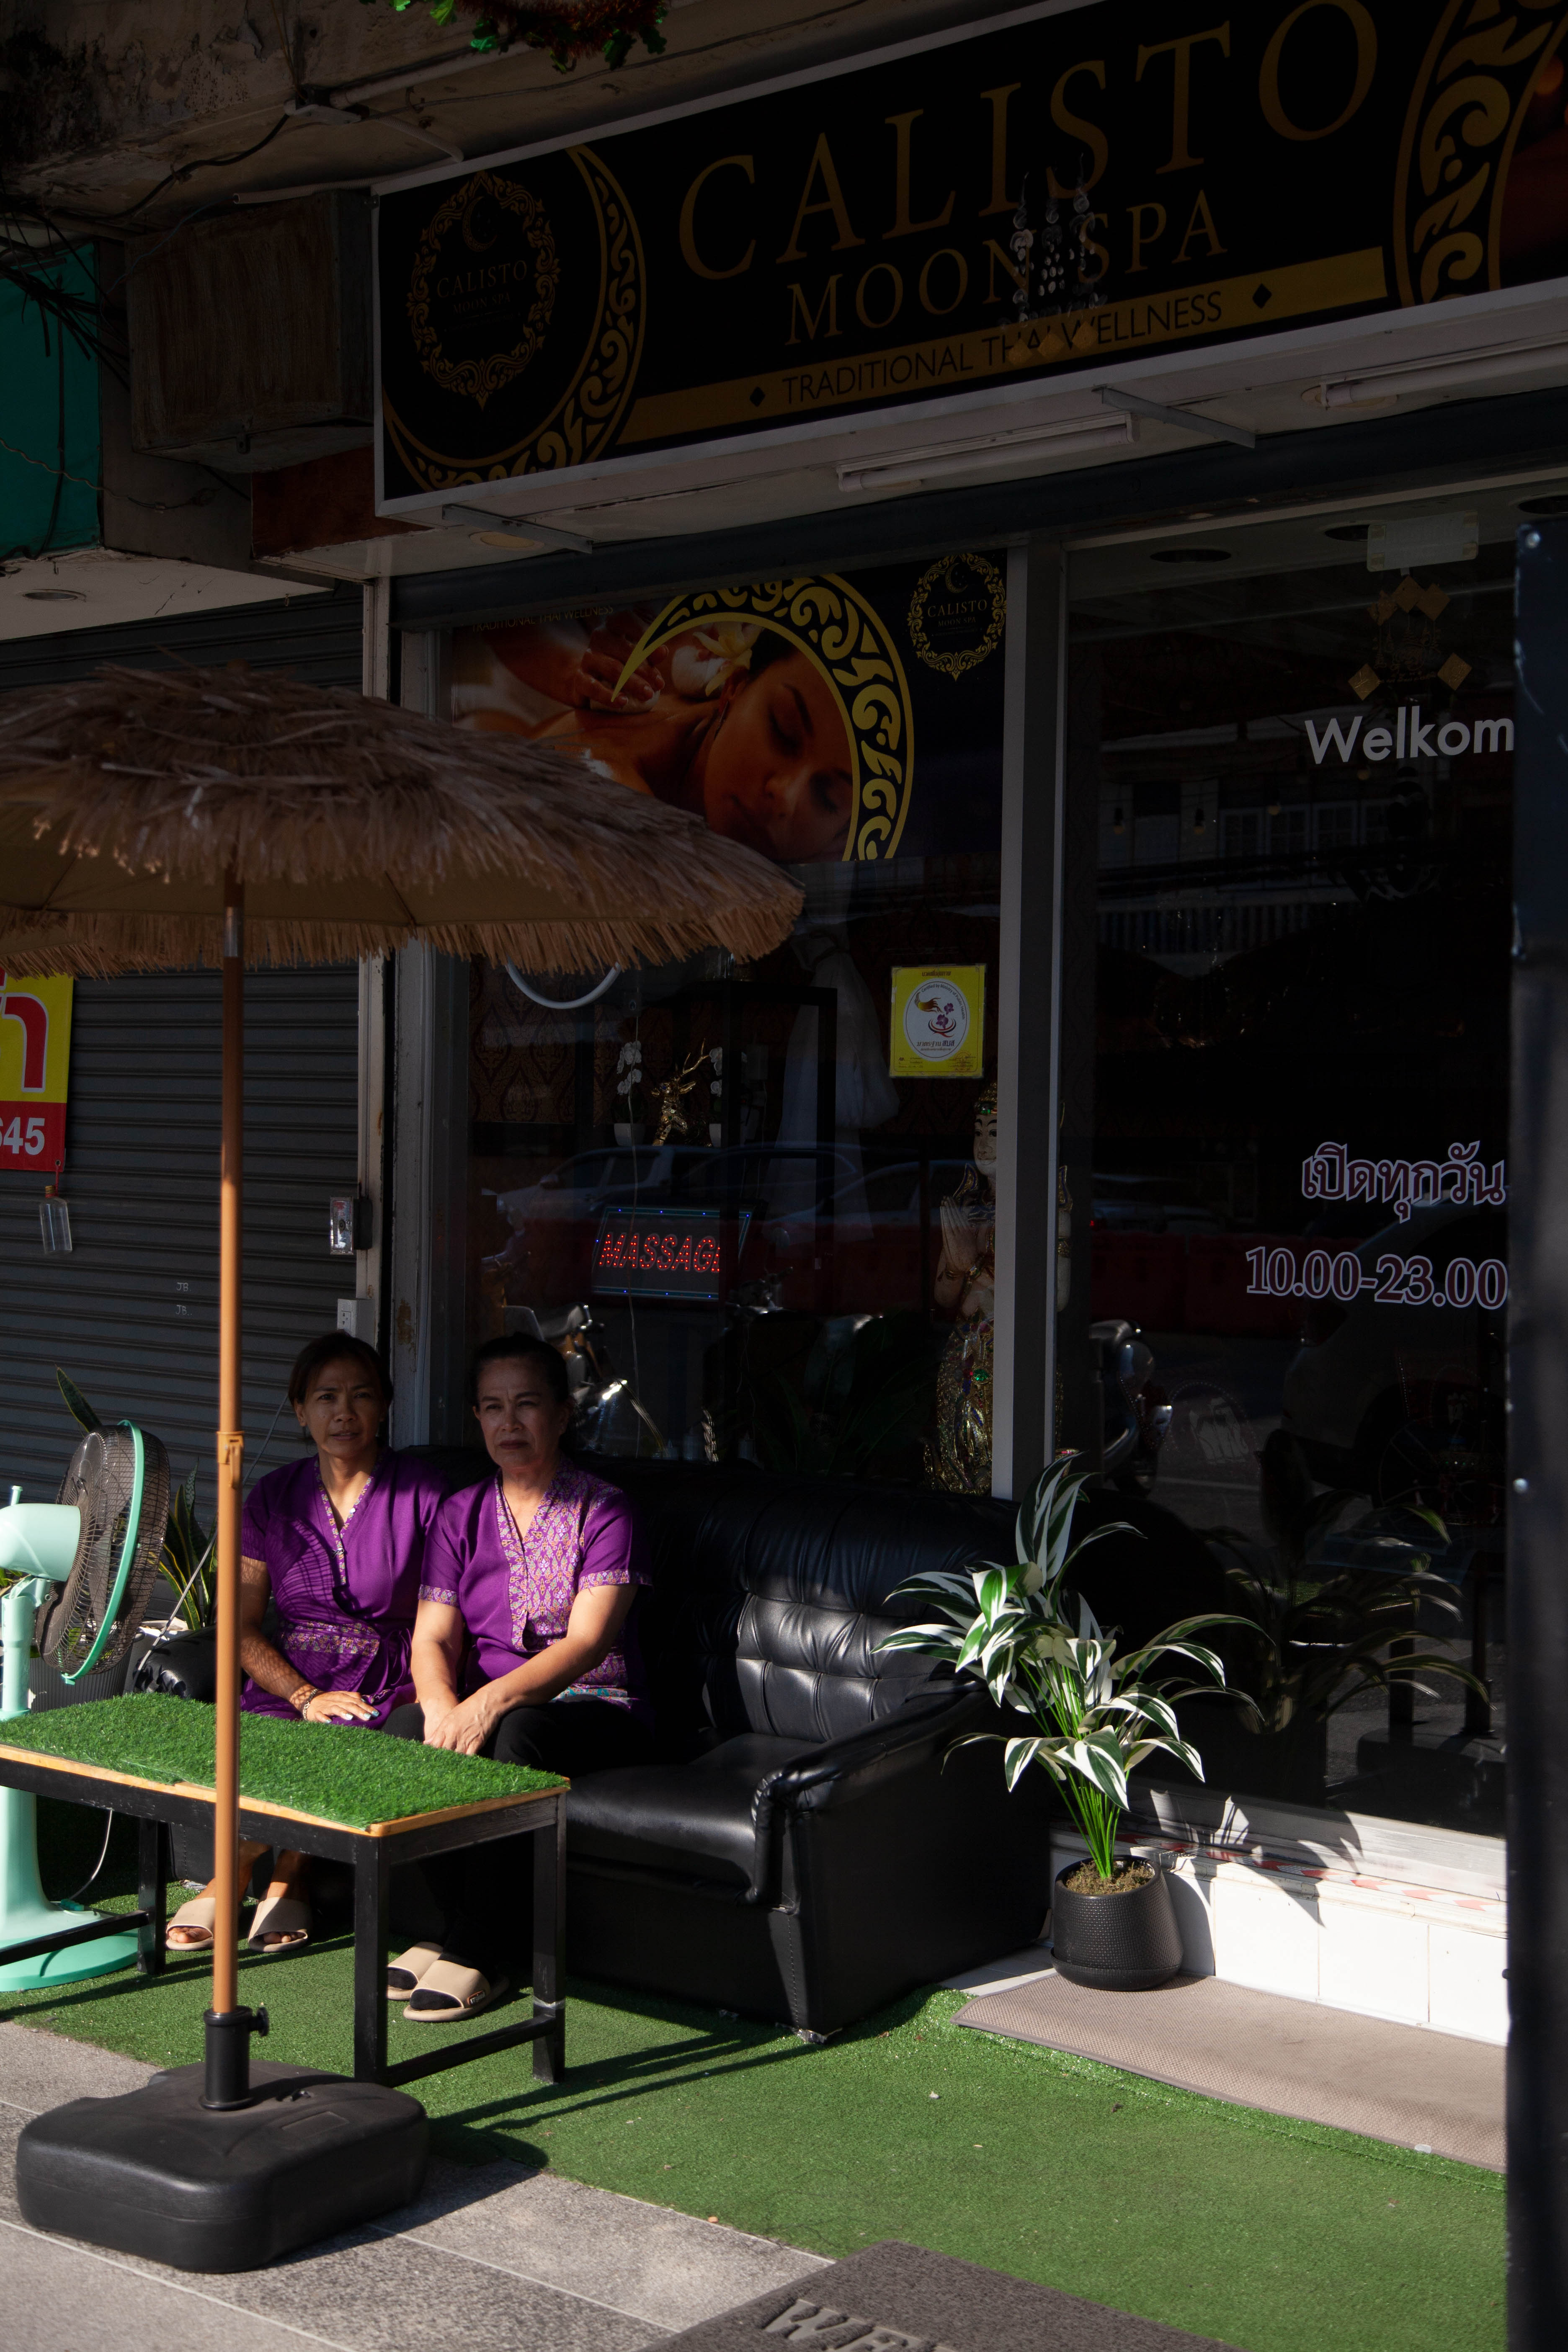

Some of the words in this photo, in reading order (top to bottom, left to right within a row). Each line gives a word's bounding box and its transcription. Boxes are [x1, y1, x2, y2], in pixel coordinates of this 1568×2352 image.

[679, 0, 1379, 281] CALISTO
[436, 259, 527, 298] CALISTO
[784, 229, 1037, 346] MOON
[1076, 188, 1228, 284] SPA
[452, 297, 489, 315] MOON
[492, 291, 511, 305] SPA
[783, 343, 973, 405] TRADITIONAL
[981, 325, 1051, 366] THA
[1062, 291, 1222, 350] WELLNESS
[928, 599, 988, 617] CALISTO
[938, 618, 961, 627] MOON
[1304, 705, 1514, 765] Welkom
[921, 984, 936, 993] Certified
[940, 984, 952, 993] Ministry
[1301, 1140, 1506, 1224] เปิดทุกวัน
[1246, 1246, 1508, 1310] 10.00-23.00
